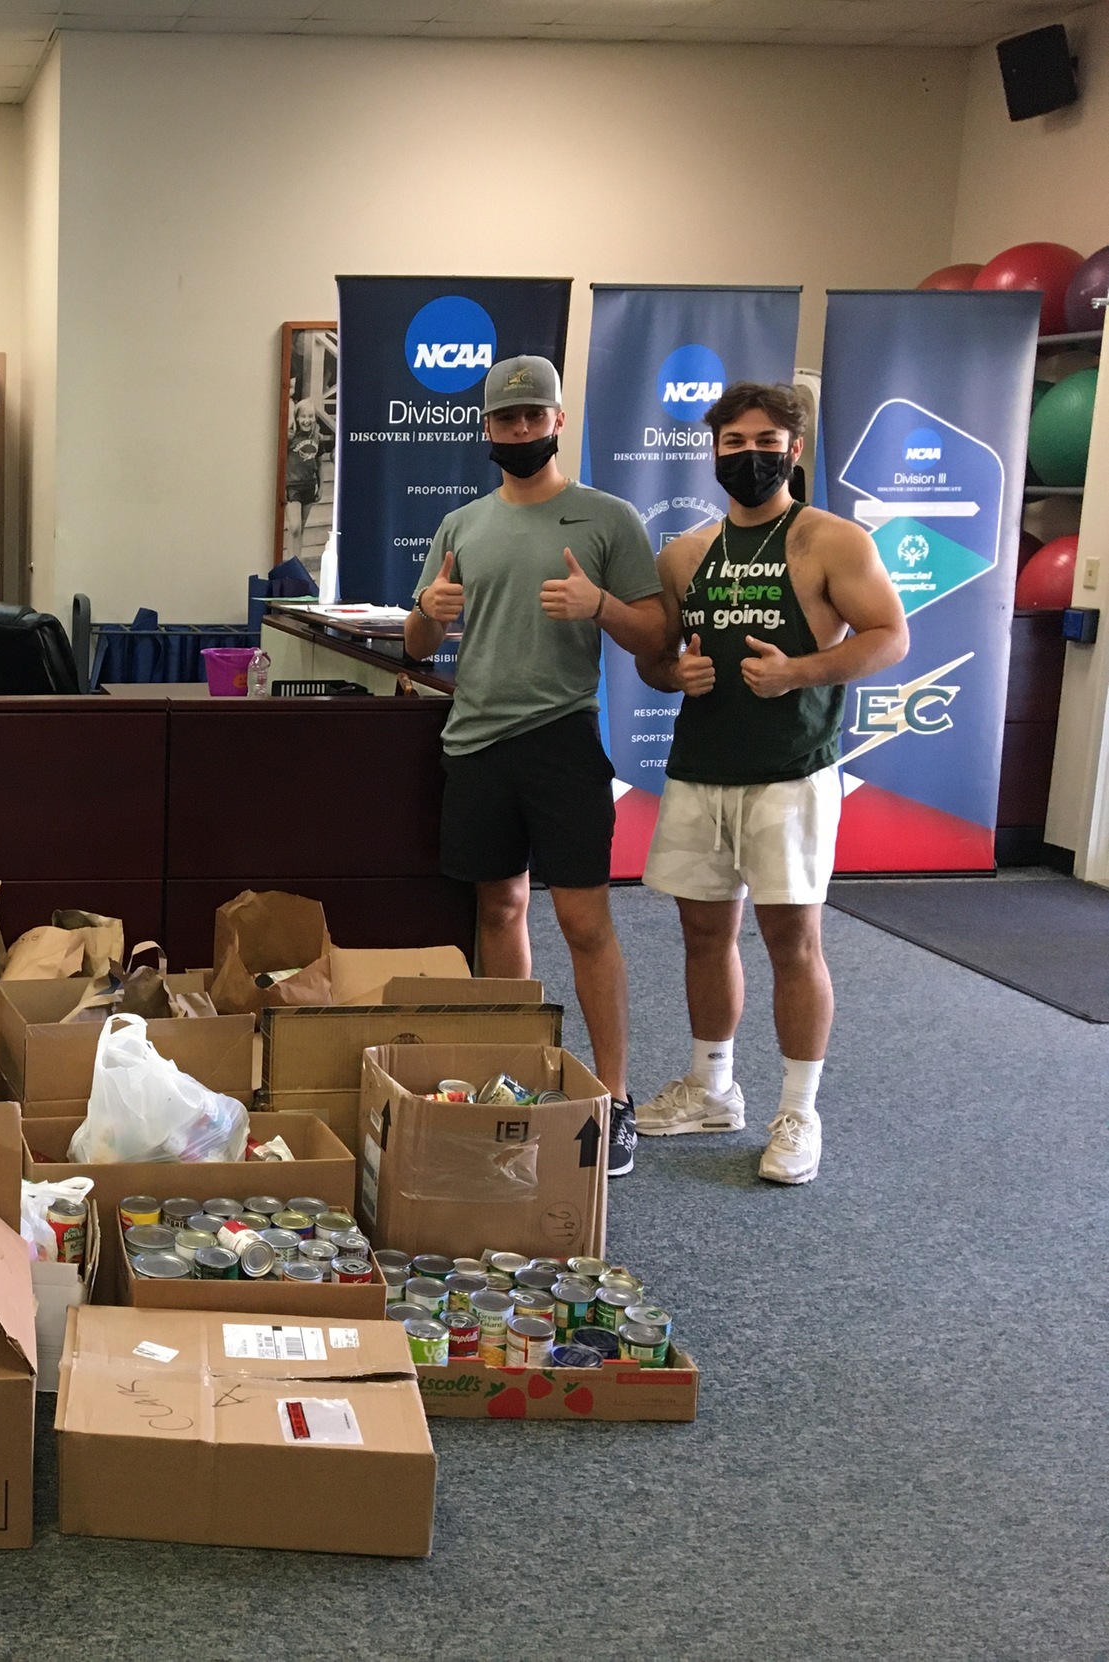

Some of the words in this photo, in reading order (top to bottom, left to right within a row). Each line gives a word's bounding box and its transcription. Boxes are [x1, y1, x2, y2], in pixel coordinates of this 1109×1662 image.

[412, 343, 492, 369] NCAA
[662, 381, 723, 403] NCAA
[388, 400, 481, 425] Division
[349, 432, 410, 442] DISCOVER
[417, 432, 474, 442] DEVELOP
[643, 427, 713, 447] Division
[613, 452, 659, 462] DISCOVER
[665, 452, 708, 462] DEVELOP
[905, 447, 942, 461] NCAA
[893, 472, 935, 485] Division
[407, 485, 478, 495] PROPORTION
[706, 559, 715, 580] i
[719, 559, 788, 580] know
[890, 571, 933, 582] Special
[707, 580, 783, 602] where
[713, 604, 786, 630] going.
[851, 685, 960, 735] EC
[478, 1312, 503, 1320] Green
[480, 1321, 503, 1329] Giant
